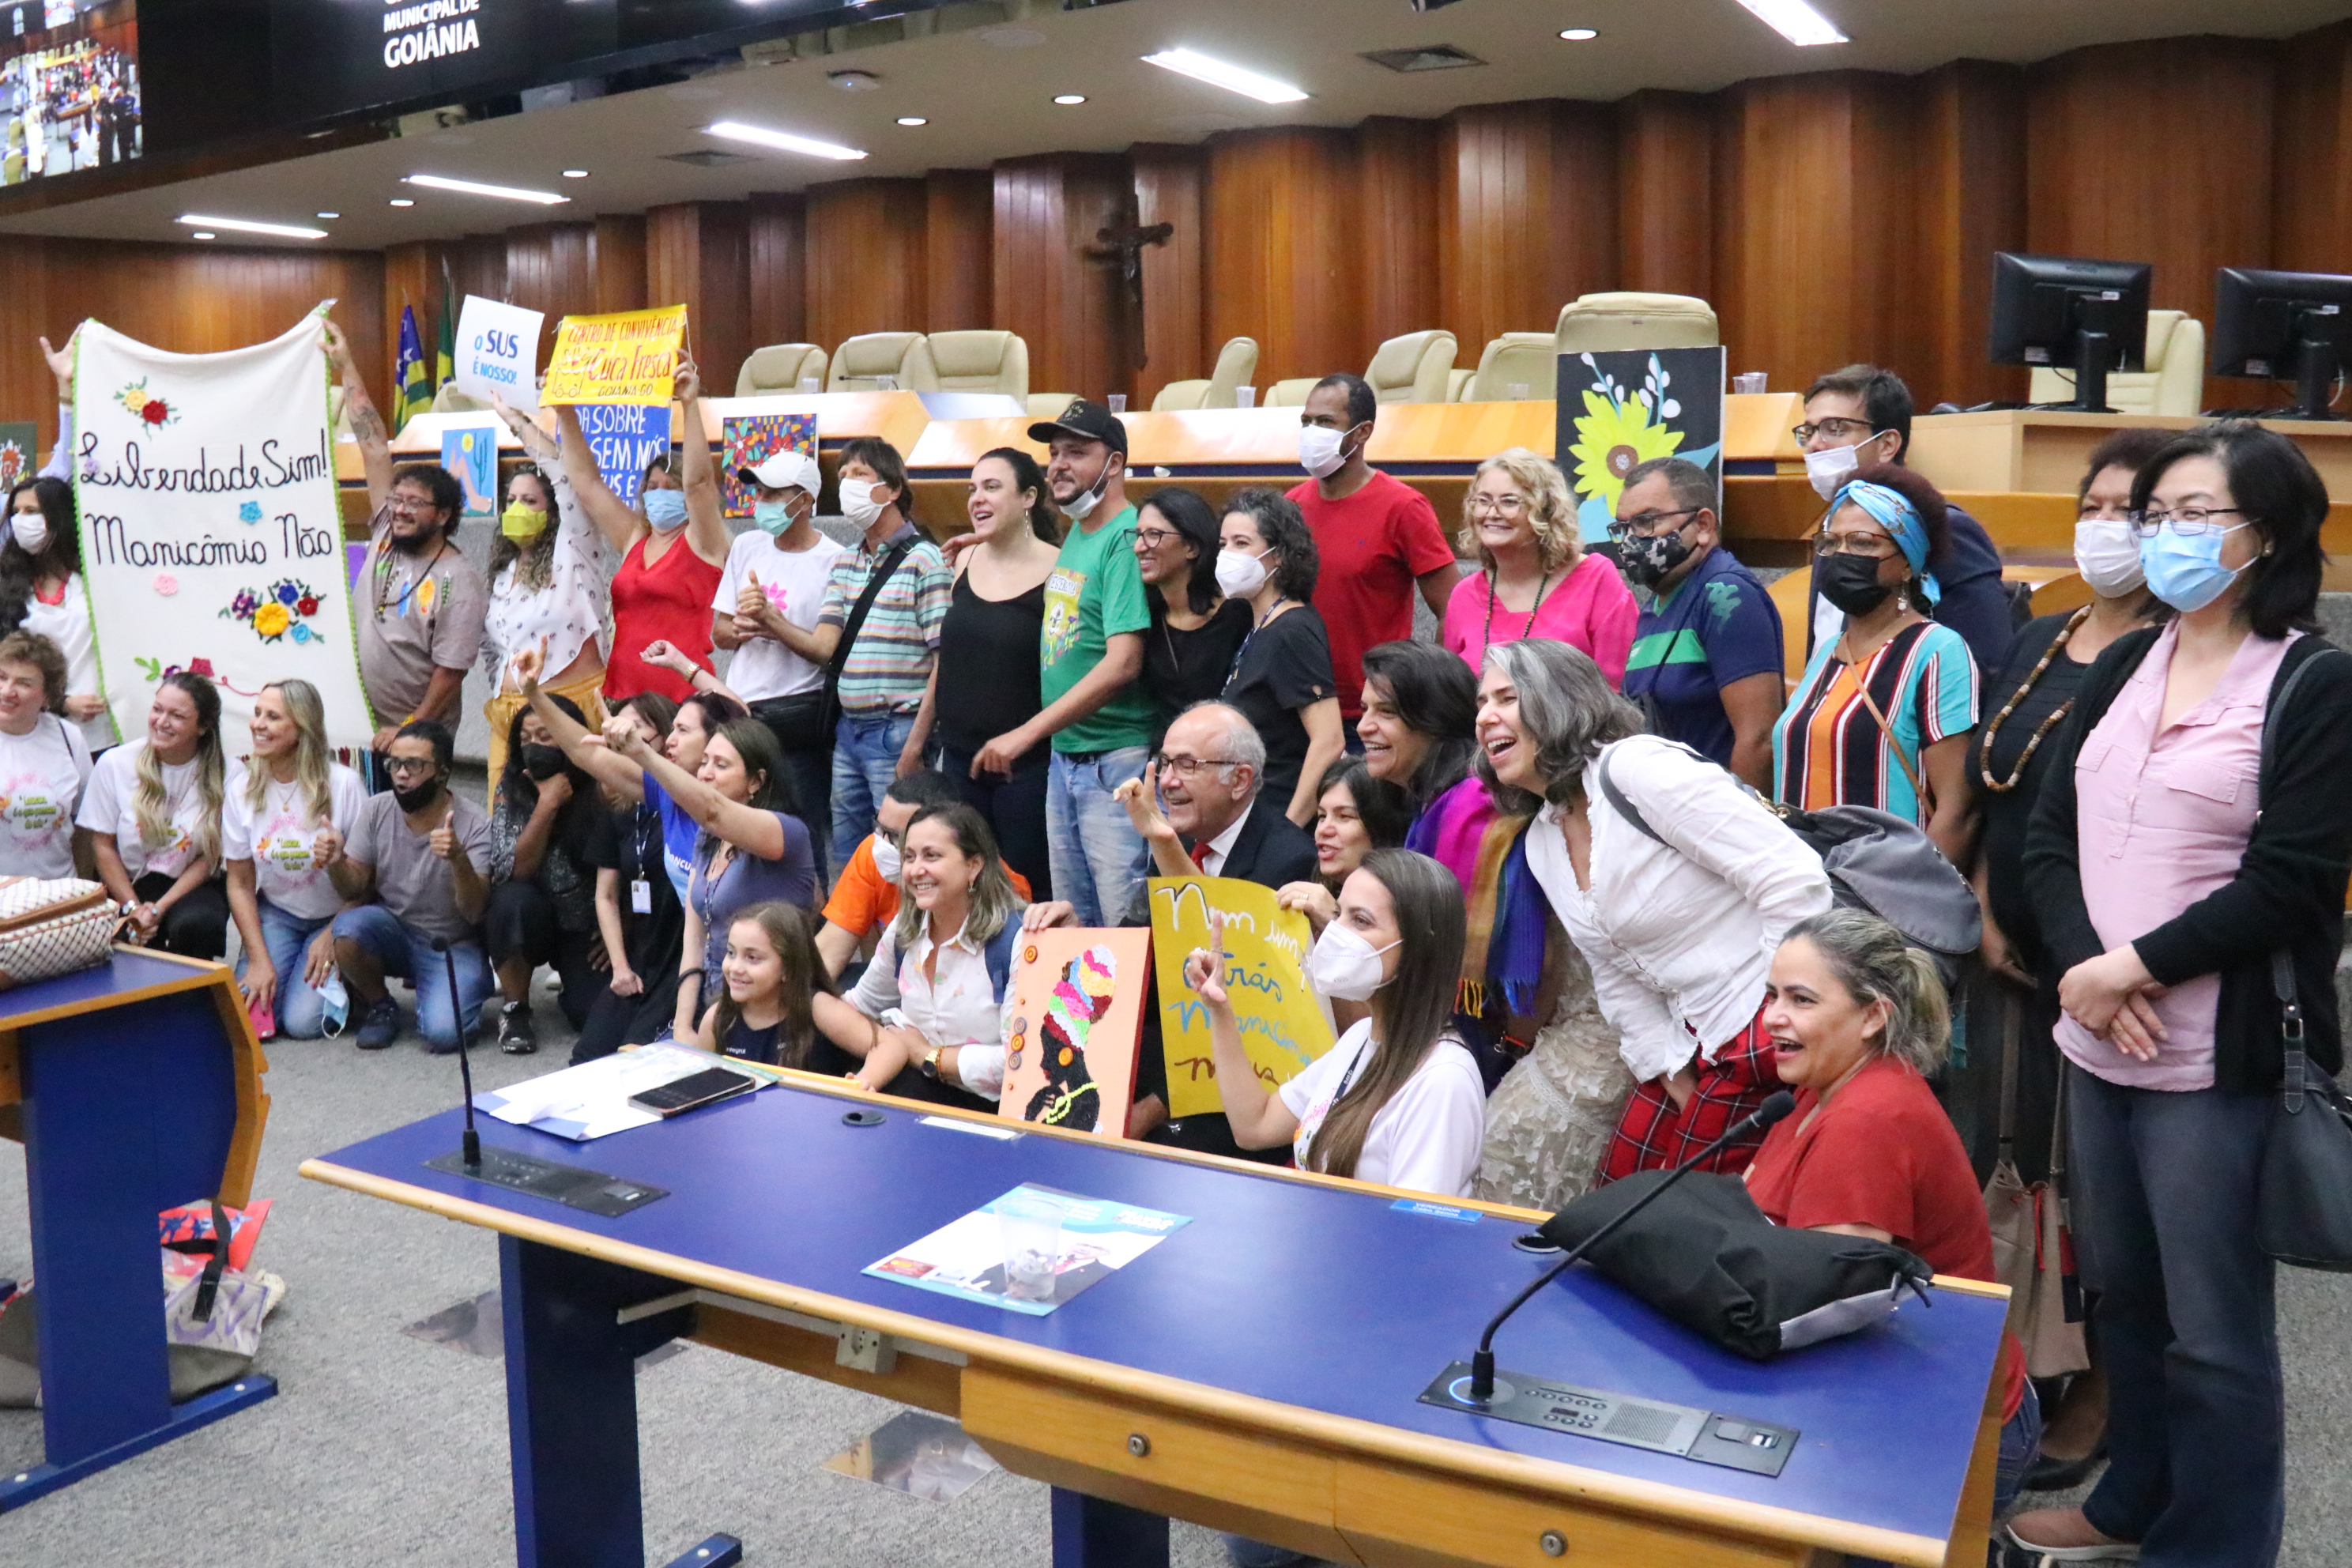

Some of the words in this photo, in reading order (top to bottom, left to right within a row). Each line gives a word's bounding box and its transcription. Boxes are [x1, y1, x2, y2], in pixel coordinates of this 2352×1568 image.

[383, 1, 459, 33] MUNICIPAL
[460, 0, 481, 13] DE
[383, 19, 481, 68] GOIÂNIA
[485, 329, 519, 359] SUS
[567, 323, 603, 342] CENTRO
[604, 322, 617, 341] DE
[473, 356, 479, 375] É
[480, 362, 518, 386] NOSSO!
[588, 348, 628, 381] Cuca
[629, 345, 672, 380] Fresca
[591, 404, 648, 435] SOBRE
[78, 432, 265, 492] Liberdade
[262, 428, 329, 488] Sim!
[590, 437, 631, 470] SEM
[85, 513, 267, 567] Manicômio
[274, 513, 333, 559] Não
